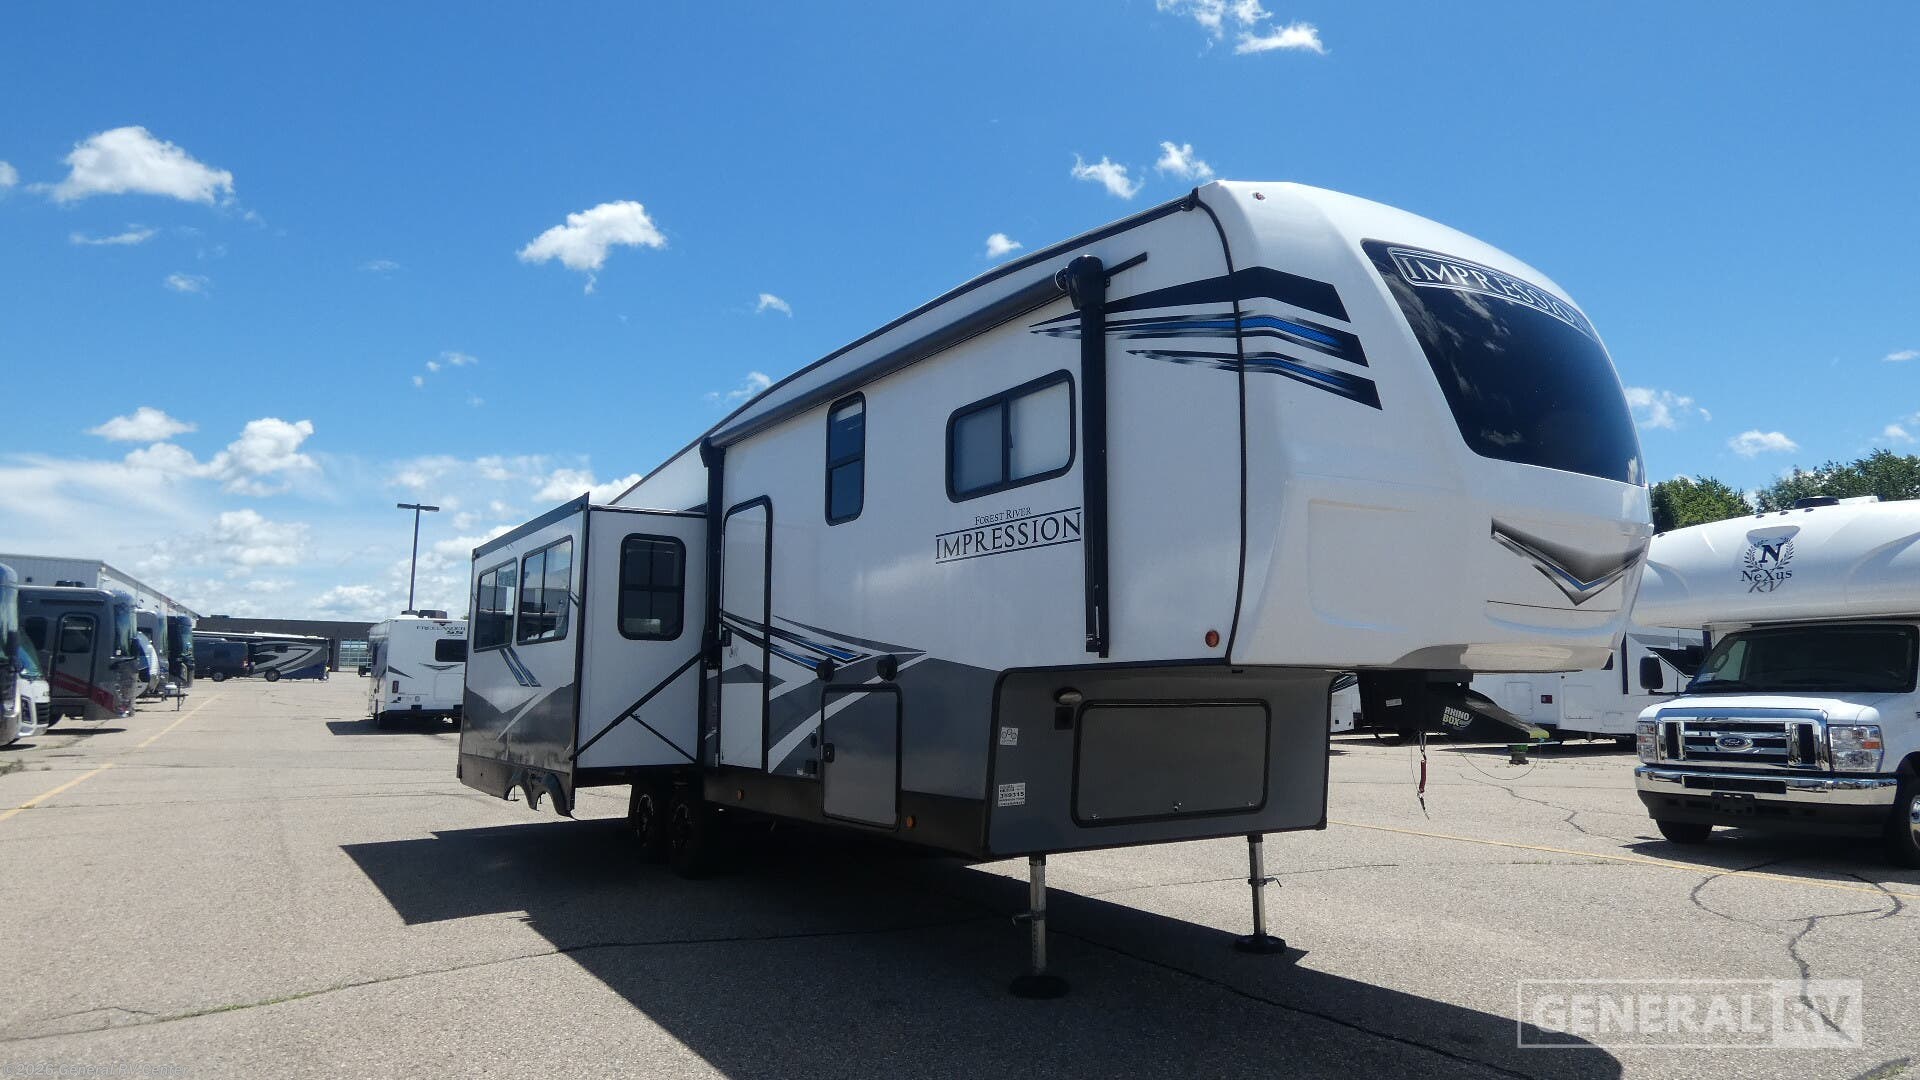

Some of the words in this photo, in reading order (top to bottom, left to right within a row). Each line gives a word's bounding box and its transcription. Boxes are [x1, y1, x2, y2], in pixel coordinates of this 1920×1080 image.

[1400, 256, 1587, 330] IMPRESSION
[975, 511, 1005, 526] FOREST
[1006, 506, 1032, 520] RIVER
[936, 511, 1082, 560] IMPRESSION
[1442, 714, 1461, 727] BOX
[1444, 706, 1470, 721] RHINO
